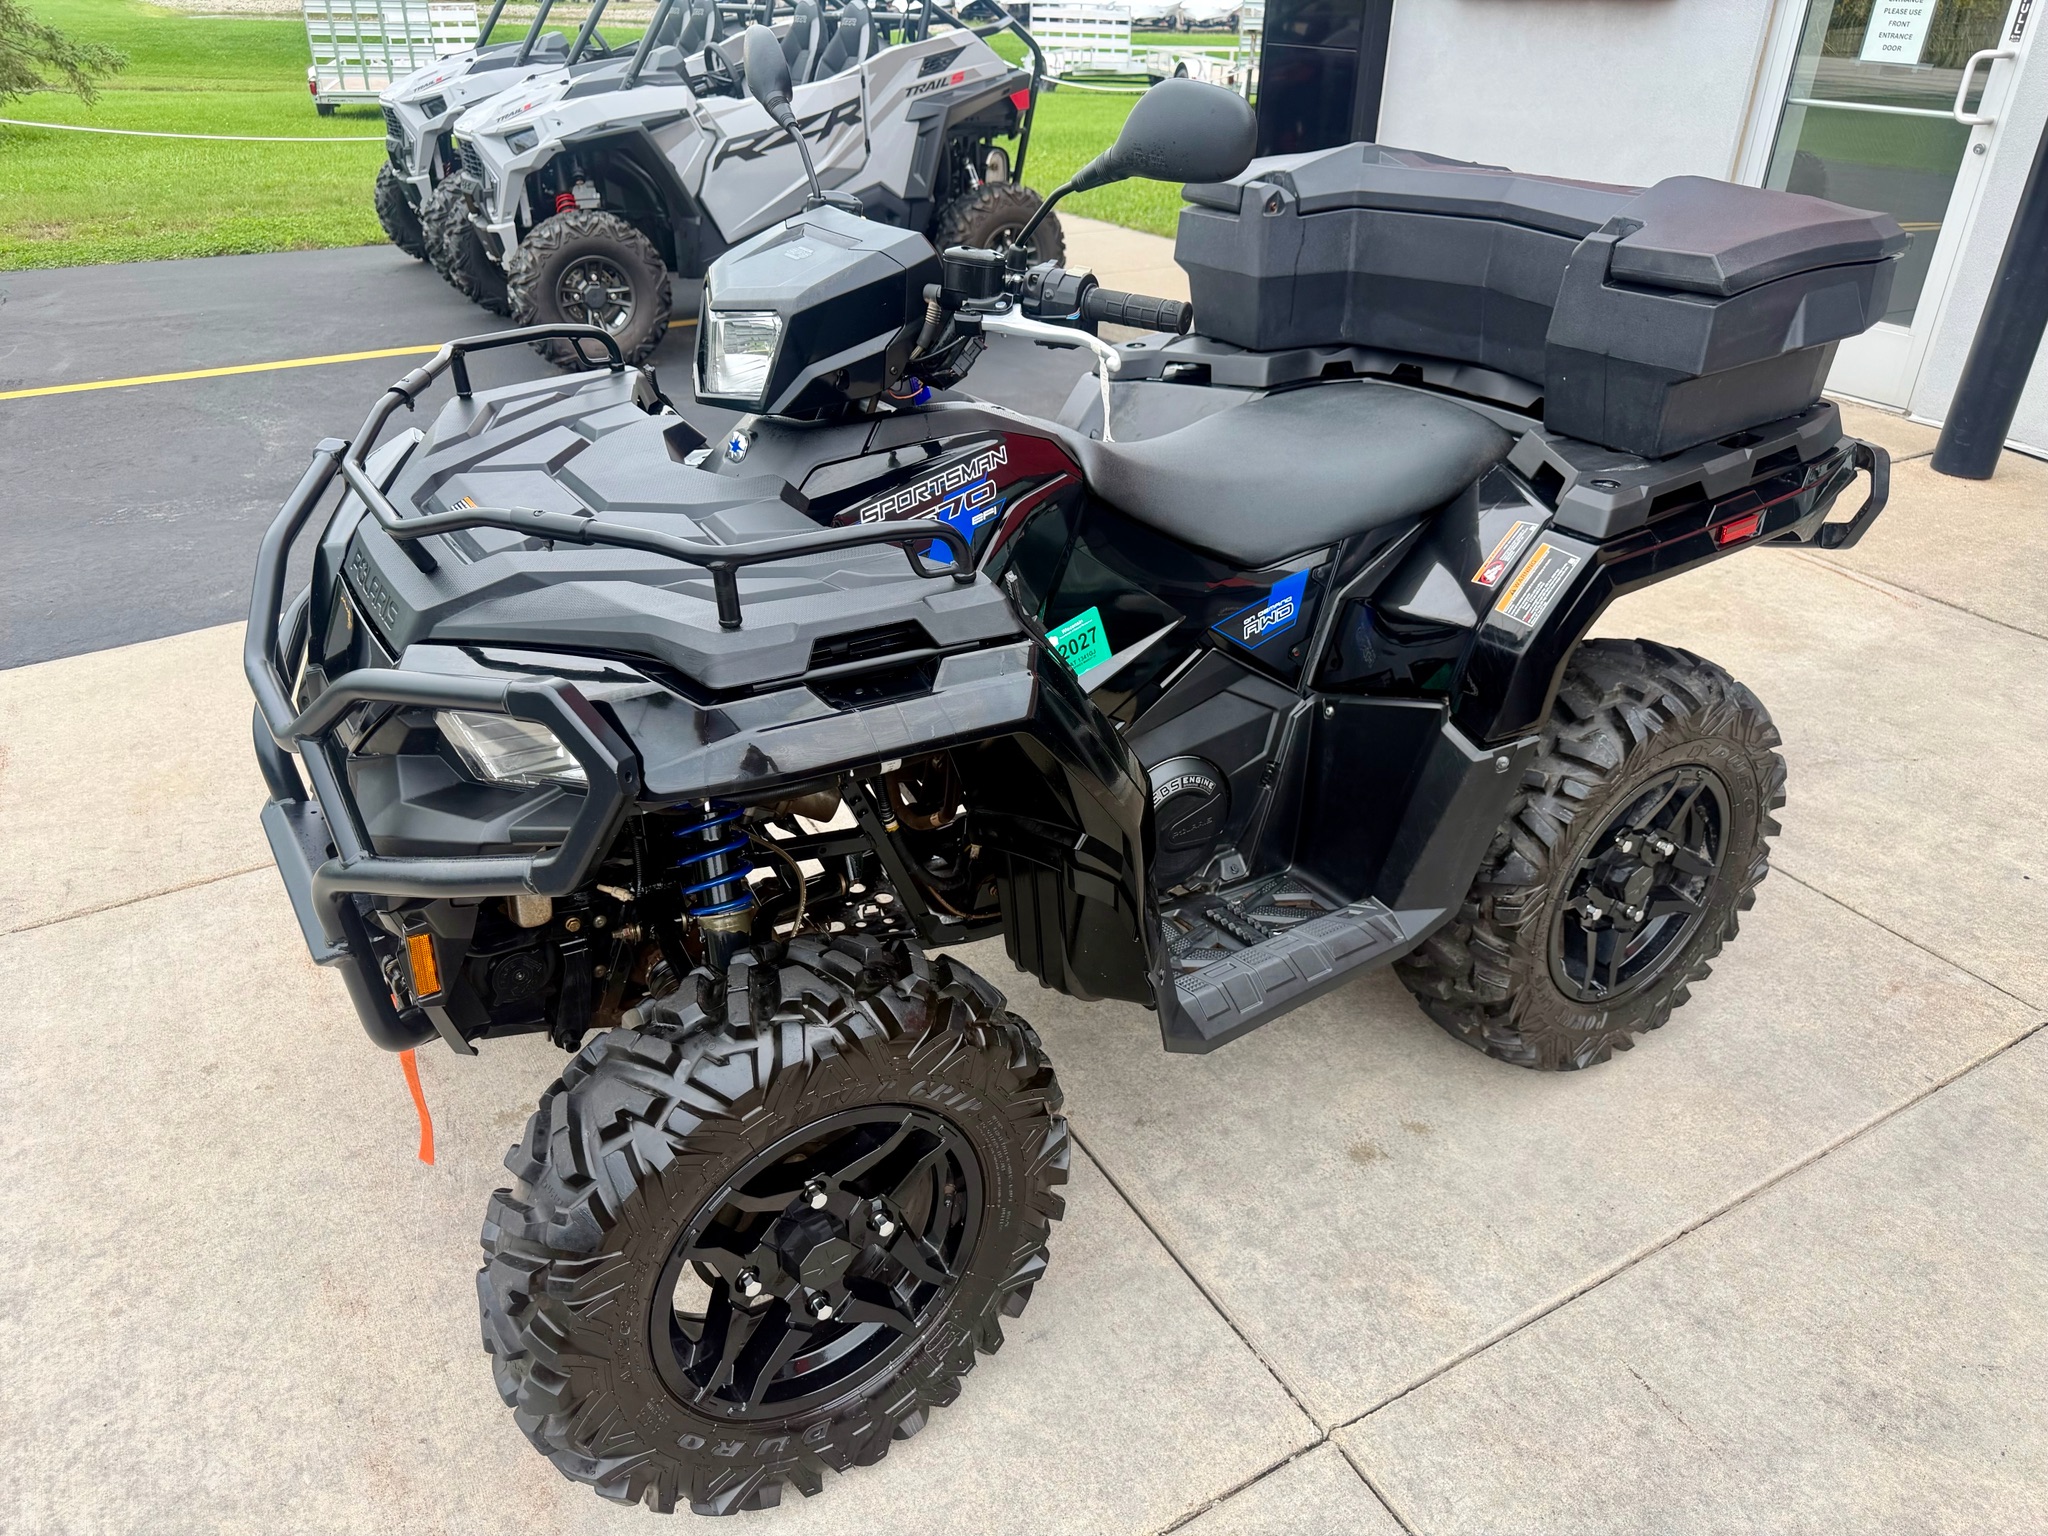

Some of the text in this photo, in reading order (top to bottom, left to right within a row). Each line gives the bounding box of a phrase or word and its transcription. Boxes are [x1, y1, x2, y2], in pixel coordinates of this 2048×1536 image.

[1884, 7, 1922, 16] PLEASE USE
[1888, 20, 1910, 28] FRONT
[2014, 0, 2031, 34] ULL
[1879, 31, 1913, 40] ENTRANCE
[1882, 44, 1902, 52] DOOR
[906, 77, 949, 98] TRAIL
[712, 96, 862, 172] RZR
[860, 445, 1008, 524] SPORTSMAN
[972, 506, 997, 526] EFI
[1512, 559, 1537, 589] WARNING
[349, 548, 400, 632] POLARIS
[1061, 619, 1083, 635] Wisconsin
[1243, 602, 1294, 640] AWD
[1058, 625, 1097, 660] 2027
[1152, 779, 1180, 806] EBS
[1182, 776, 1214, 791] ENGINE
[677, 1418, 832, 1458] DURO
